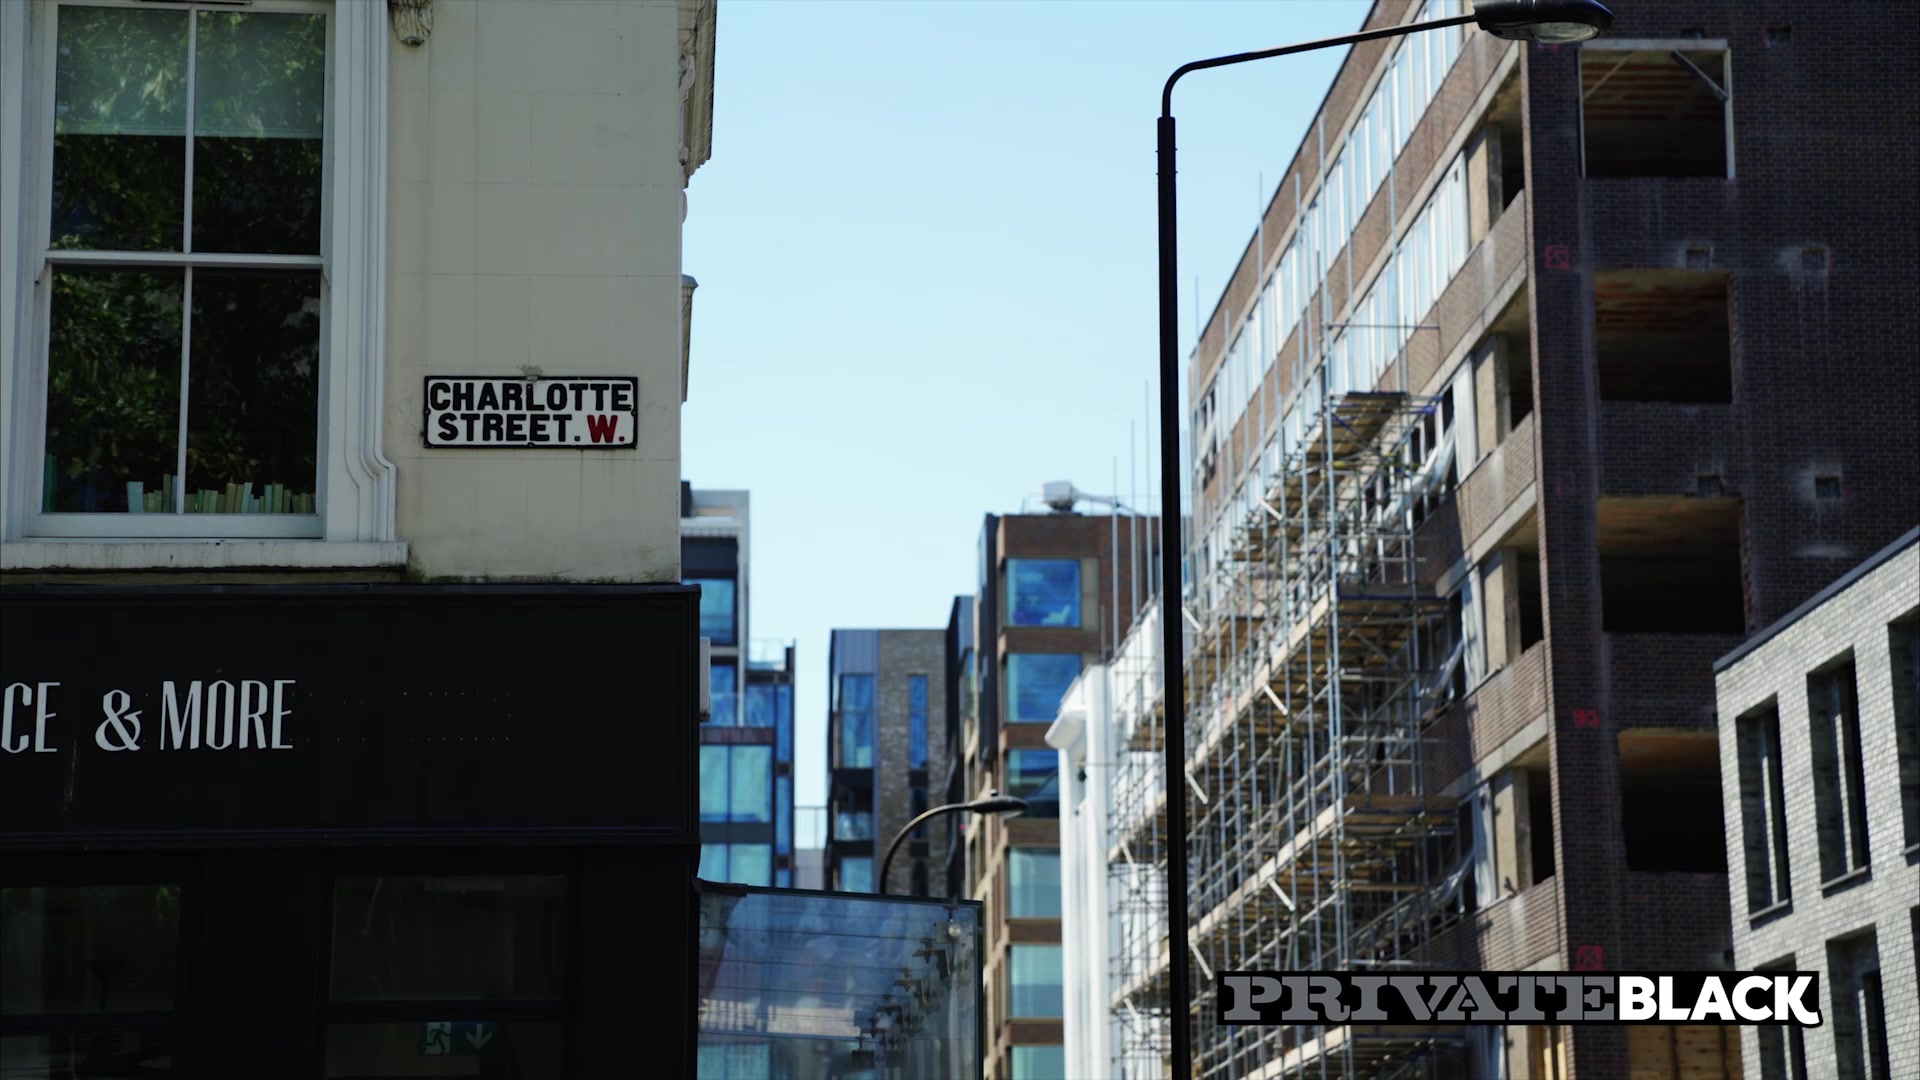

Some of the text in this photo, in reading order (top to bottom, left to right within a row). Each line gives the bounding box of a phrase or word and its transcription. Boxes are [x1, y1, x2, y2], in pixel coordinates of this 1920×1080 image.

[430, 382, 631, 411] CHARLOTTE
[95, 689, 142, 751] &
[160, 680, 295, 750] MORE
